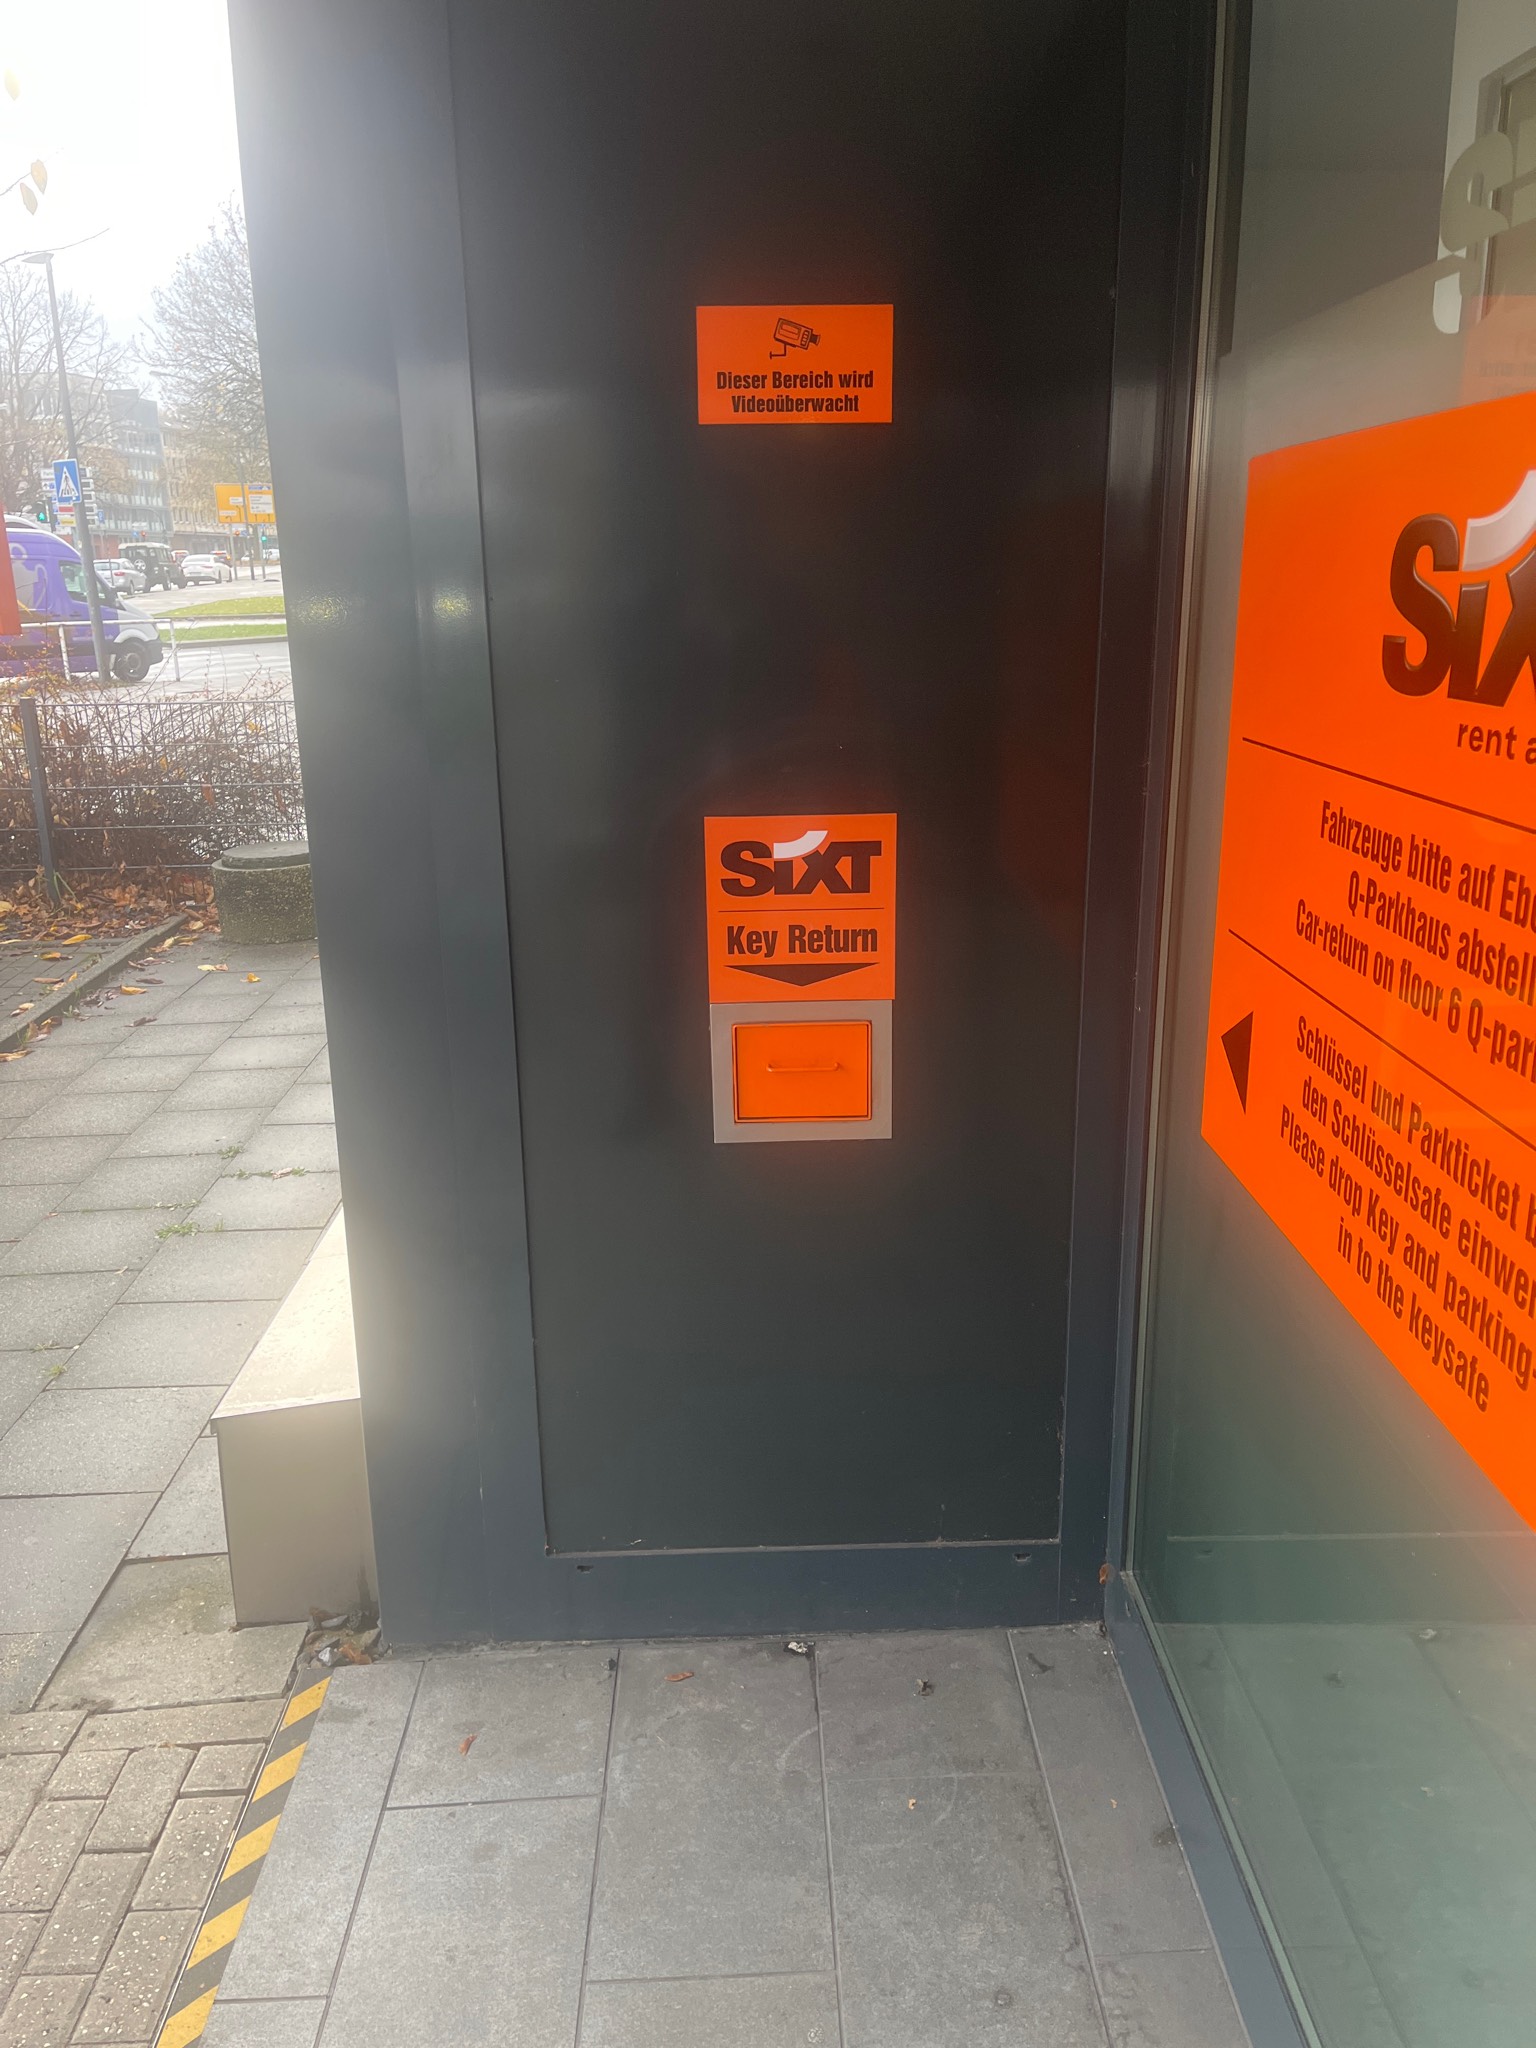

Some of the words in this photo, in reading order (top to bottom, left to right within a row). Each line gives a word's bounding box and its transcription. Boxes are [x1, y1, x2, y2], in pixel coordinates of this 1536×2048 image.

[716, 371, 767, 389] Dieser
[772, 371, 833, 388] Bereich
[838, 371, 874, 388] wird
[731, 394, 859, 413] Videoüberwacht
[1457, 723, 1517, 760] rent
[720, 830, 882, 897] SIXT
[1320, 800, 1402, 873] Fahrzeuge
[1407, 834, 1452, 894] bitte
[1458, 863, 1496, 912] auf
[727, 925, 778, 958] Key
[788, 924, 878, 953] Return
[1296, 898, 1369, 977] Car-return
[1373, 951, 1394, 993] on
[1399, 958, 1444, 1022] floor
[1448, 987, 1462, 1034] 6
[1348, 870, 1451, 961] Q-Parkhaus
[1297, 1015, 1368, 1104] Schlüssel
[1371, 1080, 1404, 1135] und
[1408, 1102, 1520, 1232] Parkticket
[1302, 1075, 1327, 1127] den
[1331, 1099, 1451, 1240] Schlüsselsafe
[1281, 1104, 1325, 1178] Please
[1329, 1155, 1362, 1217] drop
[1366, 1188, 1399, 1255] Key
[1403, 1233, 1440, 1294] and
[1338, 1216, 1352, 1264] in
[1357, 1237, 1372, 1284] to
[1377, 1258, 1404, 1319] the
[1408, 1292, 1489, 1413] keysafe
